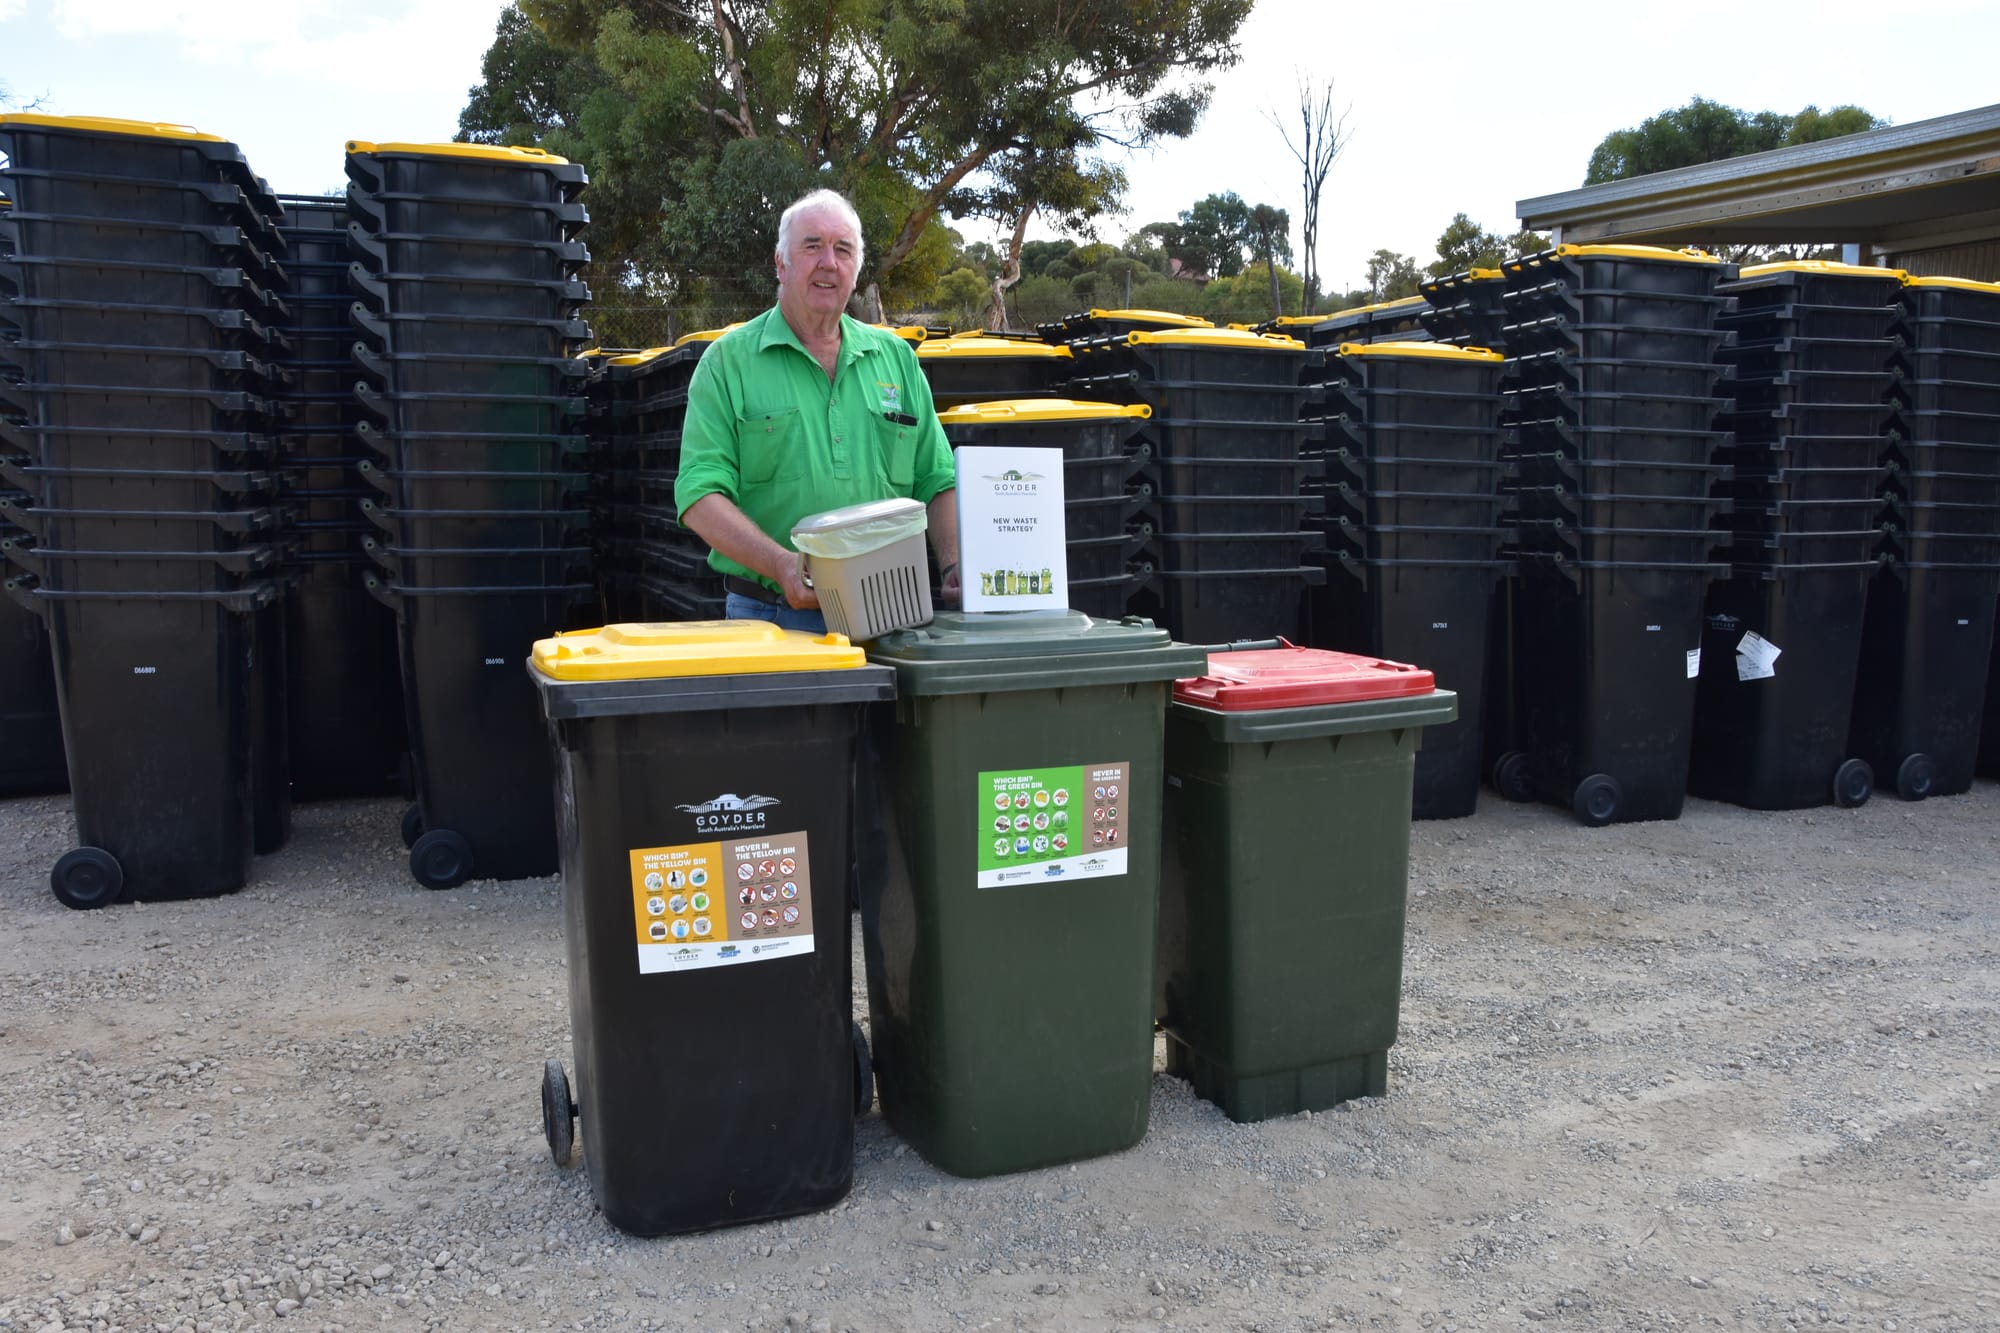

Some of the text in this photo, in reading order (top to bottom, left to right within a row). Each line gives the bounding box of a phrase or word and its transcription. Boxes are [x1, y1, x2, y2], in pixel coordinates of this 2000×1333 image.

[994, 775, 1033, 785] WHICH BIN?
[1007, 782, 1030, 790] GREEN
[1031, 781, 1043, 789] BIN
[696, 812, 766, 826] GOYDER
[740, 823, 766, 831] Heartland
[735, 843, 760, 853] NEVER
[643, 851, 689, 862] WHICH BIN?
[736, 846, 796, 861] THE YELLOW BIN
[643, 857, 707, 870] THE YELLOW BIN
